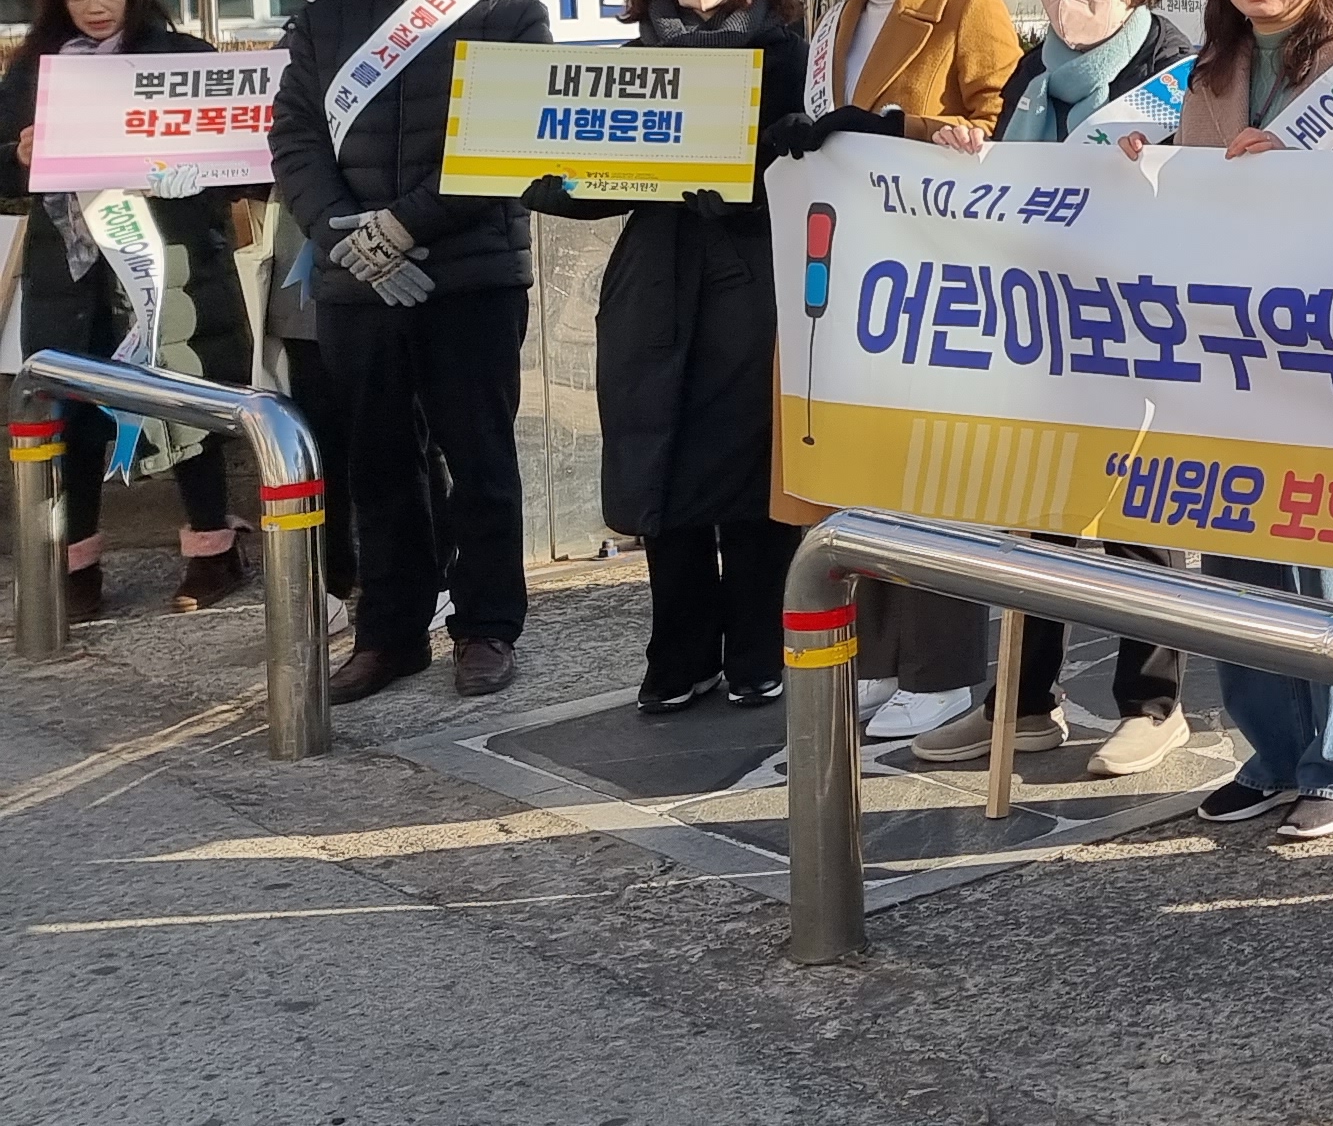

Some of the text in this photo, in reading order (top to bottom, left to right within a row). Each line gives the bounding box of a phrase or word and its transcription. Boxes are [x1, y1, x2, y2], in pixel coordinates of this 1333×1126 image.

[134, 67, 271, 99] 뿌리뽑자
[548, 64, 680, 100] 내가먼저
[335, 86, 358, 113] 잘
[125, 105, 272, 138] 학교폭력!
[537, 107, 683, 144] 서행운행!
[1017, 186, 1090, 227] 부터
